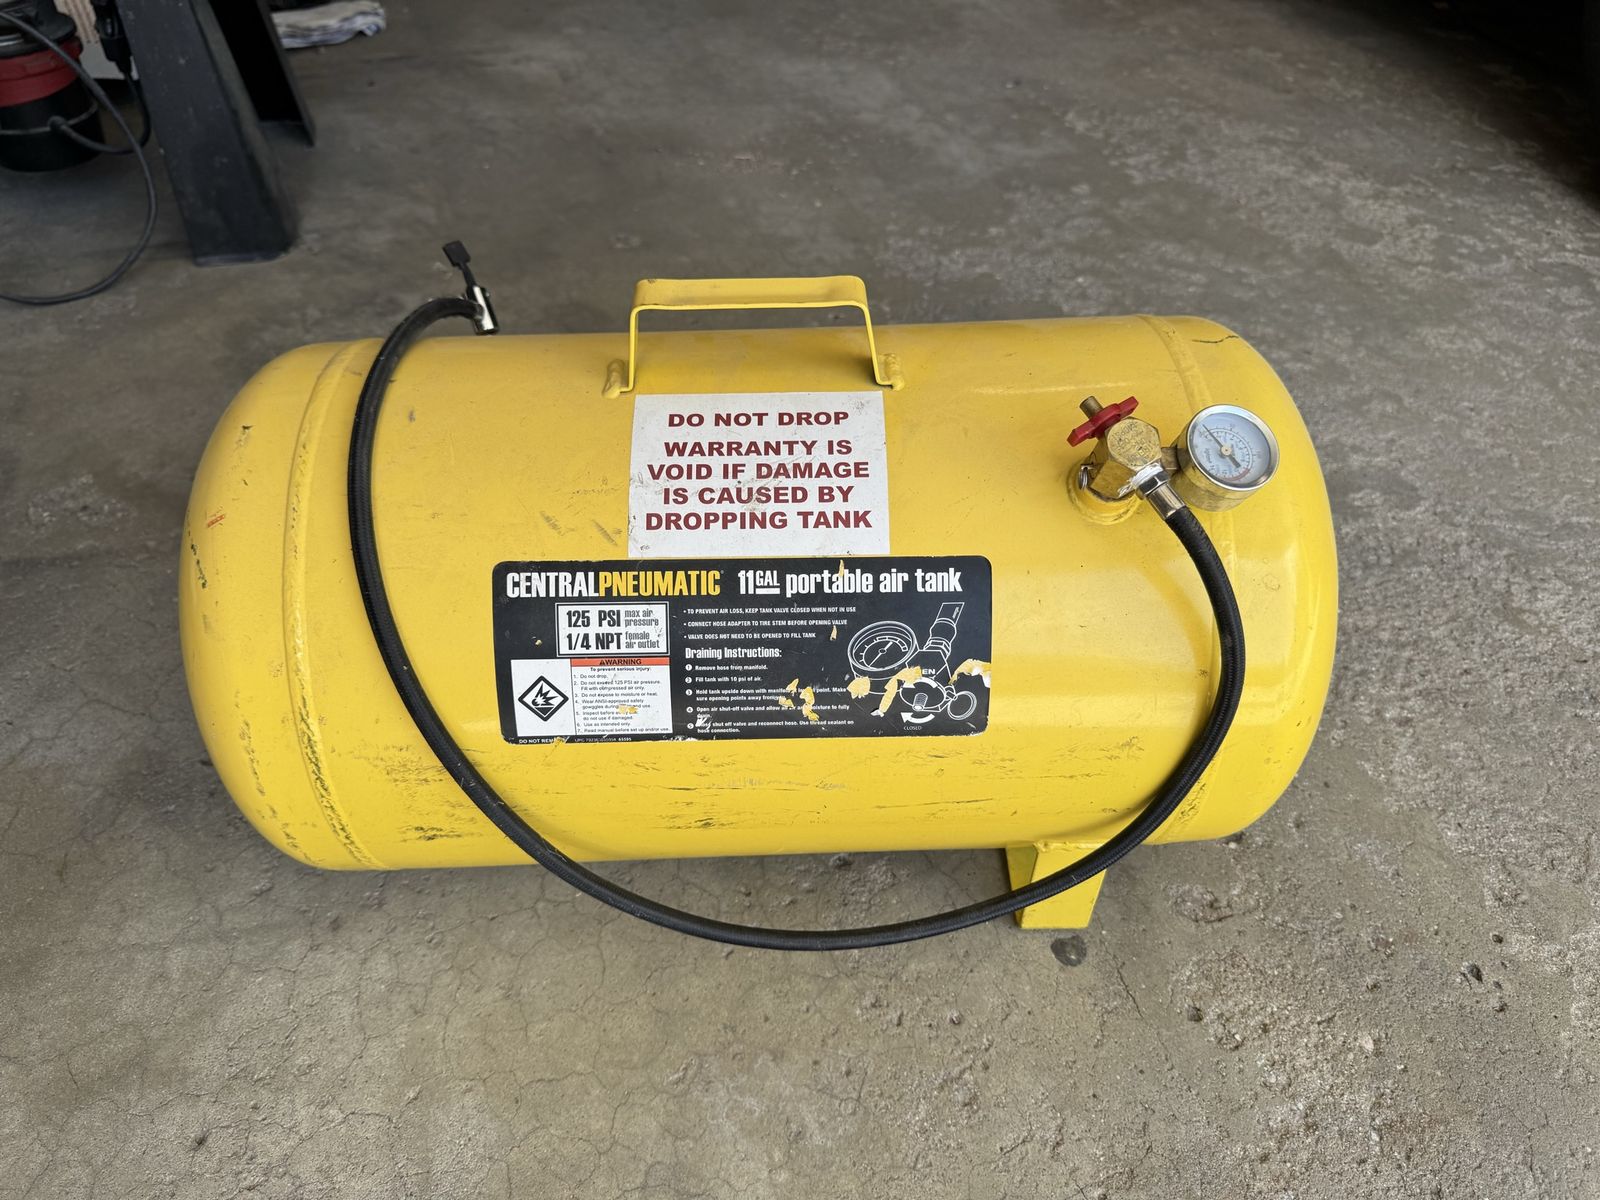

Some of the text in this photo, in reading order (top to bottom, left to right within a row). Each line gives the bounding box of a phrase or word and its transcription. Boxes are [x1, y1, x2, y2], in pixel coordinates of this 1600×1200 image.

[668, 411, 849, 427] DO NOT DROP
[664, 440, 852, 457] WARRANTY IS
[647, 461, 870, 480] VOID IF DAMAGE
[663, 485, 854, 505] IS CAUSED BY
[645, 510, 872, 531] DROPPING TANK
[786, 569, 873, 598] portable
[879, 570, 908, 593] air
[914, 568, 963, 593] tank
[566, 609, 621, 628] 125 PSI
[643, 608, 653, 617] air
[624, 618, 659, 627] pressure
[566, 633, 623, 651] 1/4 NPT
[625, 631, 650, 641] female
[625, 639, 660, 649] air outlet
[685, 647, 782, 660] Draining Instructions:
